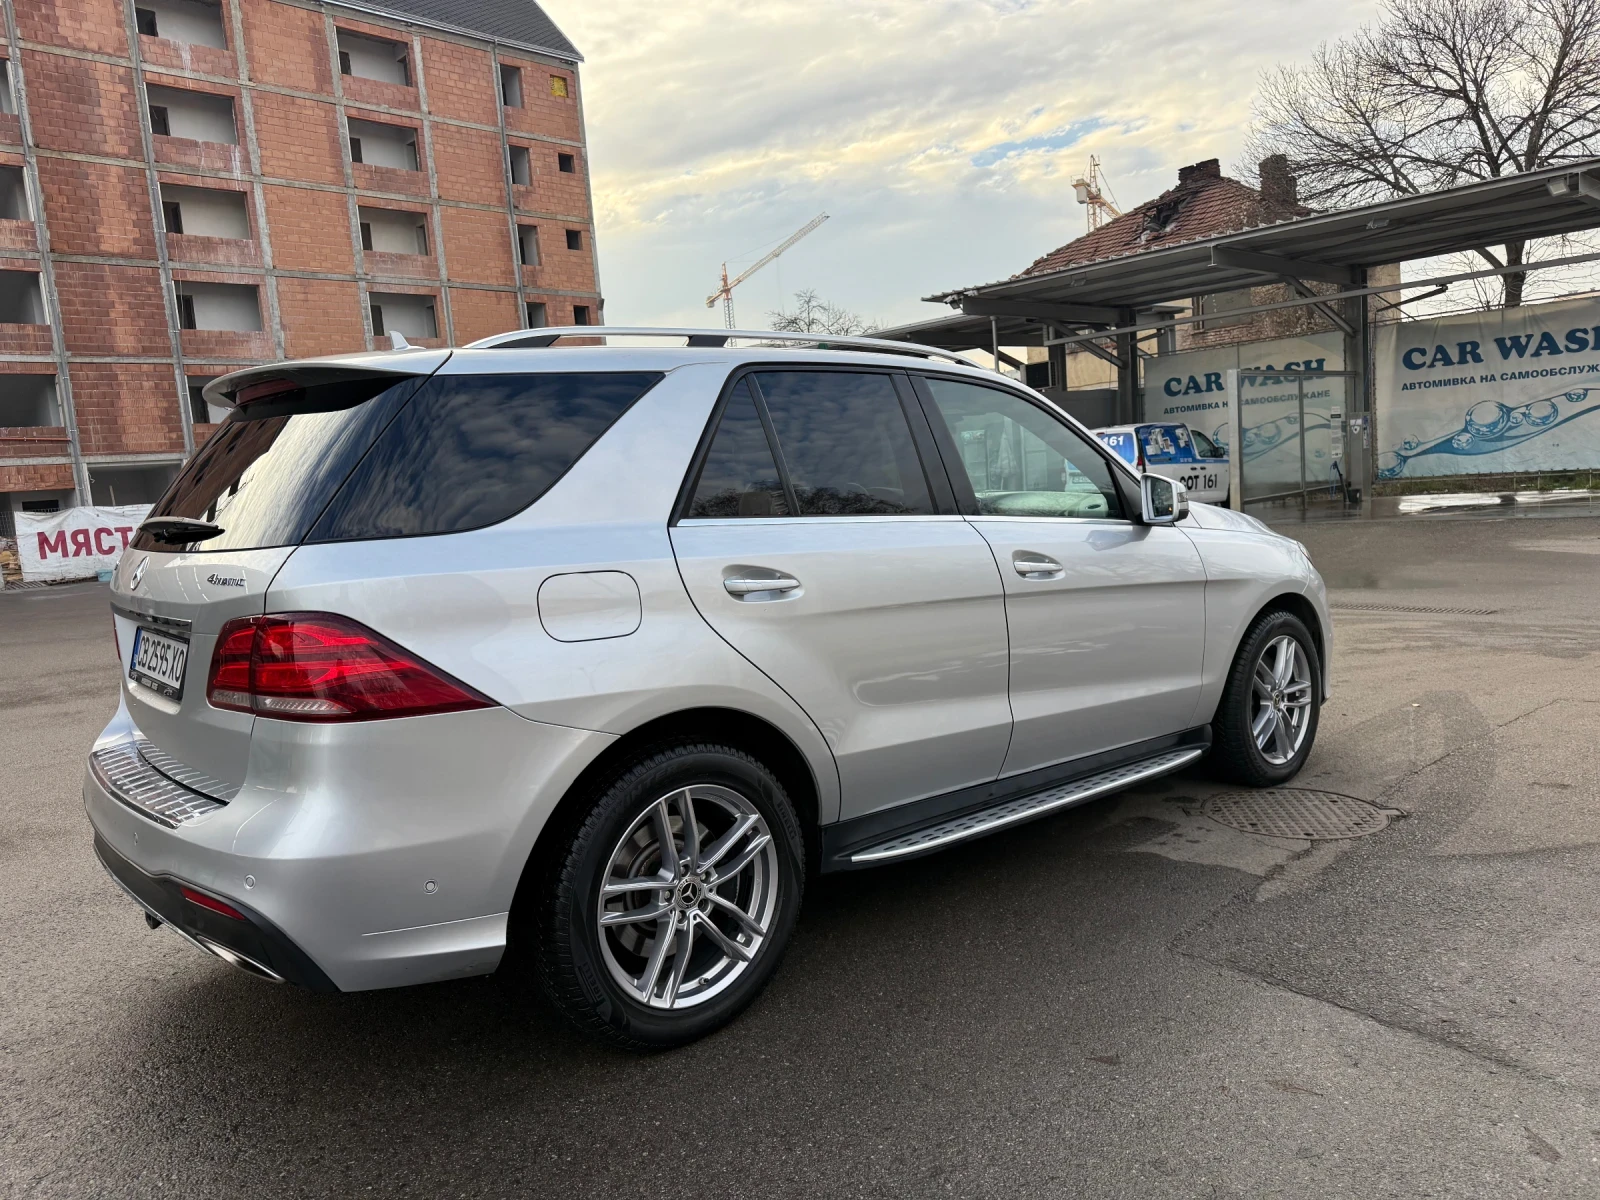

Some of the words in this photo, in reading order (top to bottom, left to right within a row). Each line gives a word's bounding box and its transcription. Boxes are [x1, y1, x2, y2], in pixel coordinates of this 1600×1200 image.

[1402, 341, 1485, 371] CAR
[1164, 372, 1225, 397] CAR
[1402, 376, 1476, 391] АВТОМИВКА
[1480, 374, 1497, 383] НА
[1500, 364, 1600, 381] САМООБСЛУЖ
[1164, 401, 1220, 414] АВТОМИВКА
[1102, 435, 1124, 446] 161
[1203, 474, 1217, 489] 161
